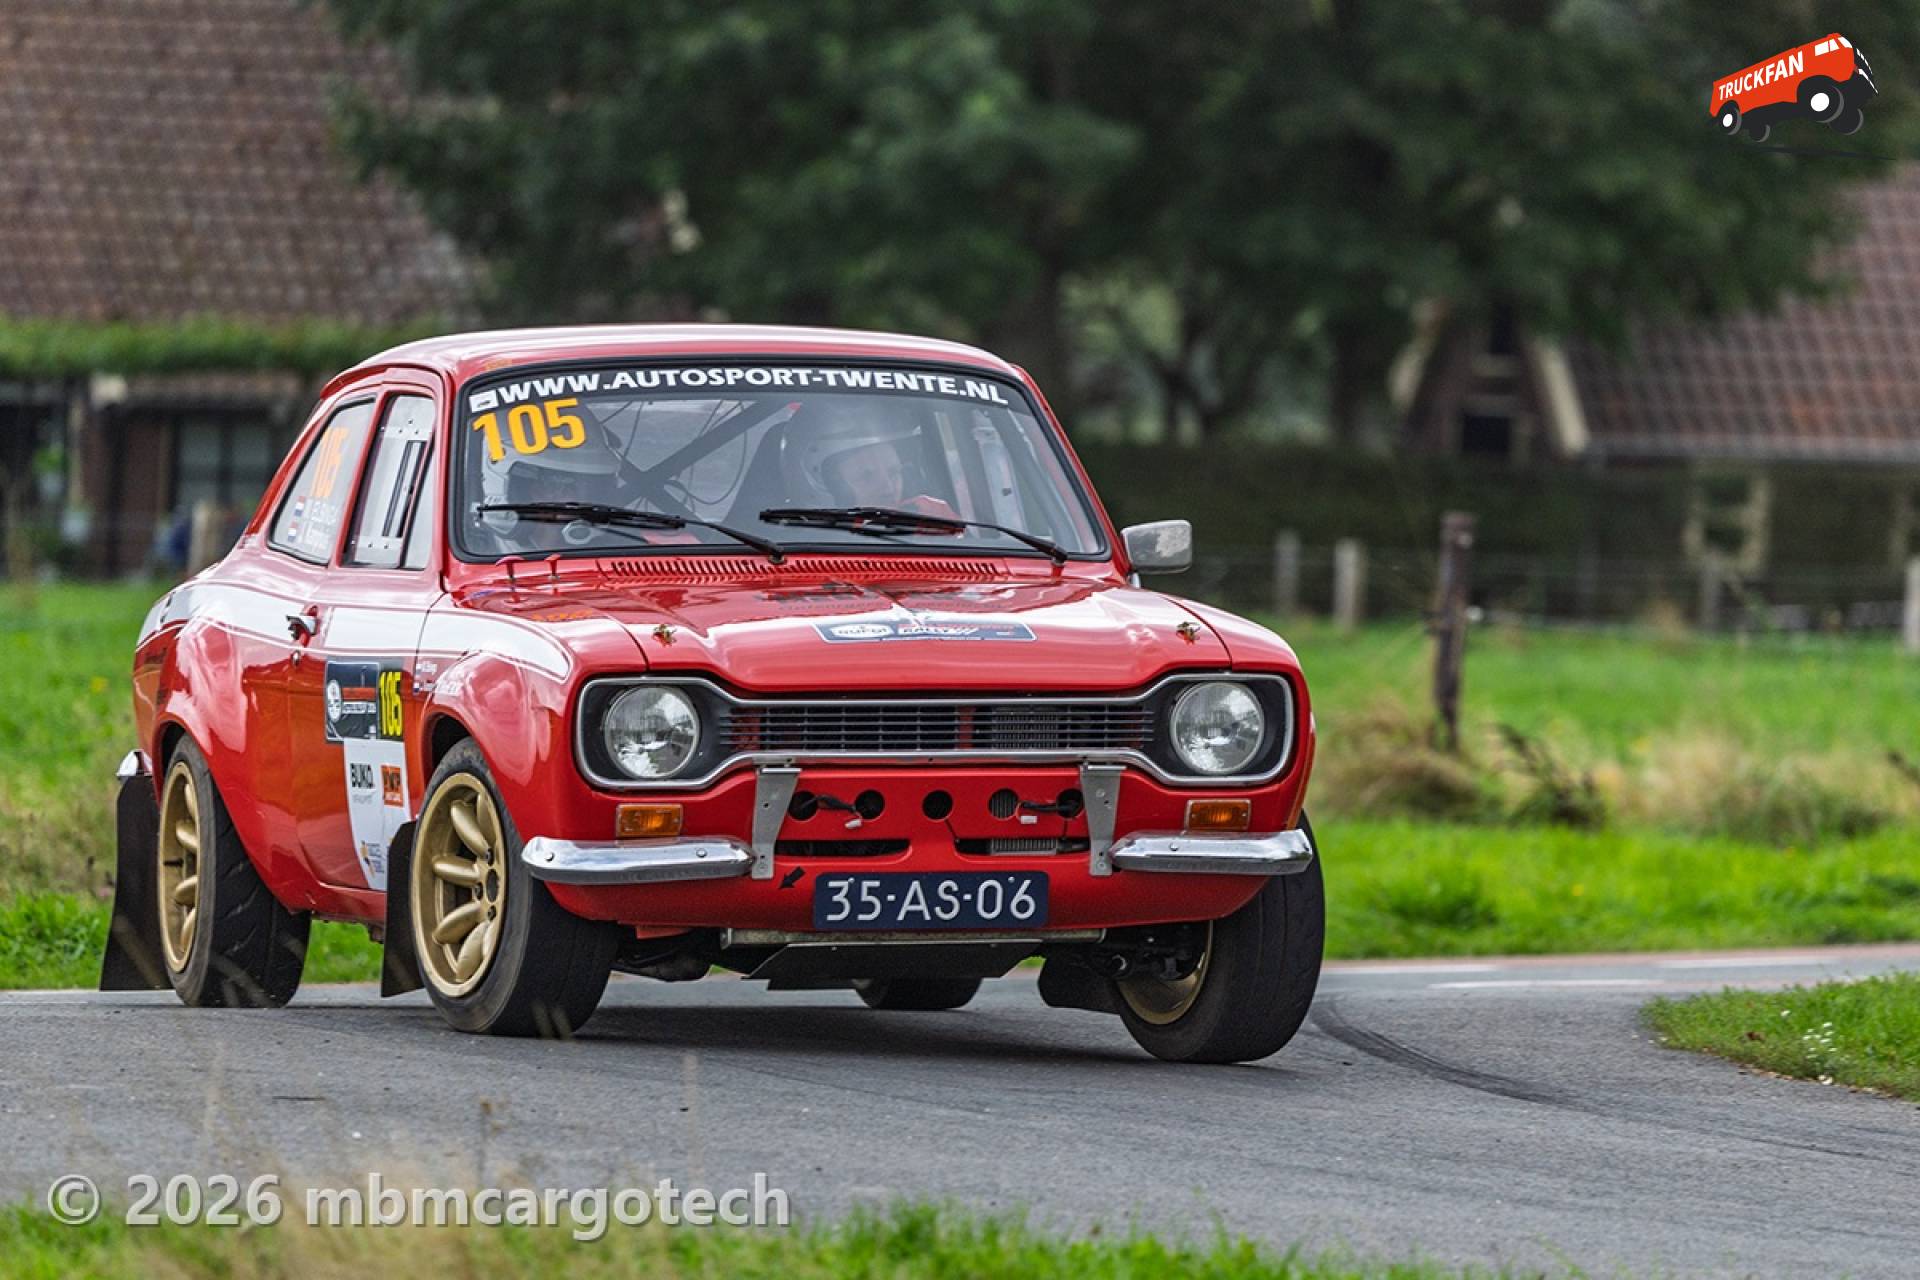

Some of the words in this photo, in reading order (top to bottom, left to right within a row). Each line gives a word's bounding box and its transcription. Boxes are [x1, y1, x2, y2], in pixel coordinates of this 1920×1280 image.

[499, 367, 1009, 405] WWW.AUTOSPORT-TWENTE.NL
[473, 398, 586, 462] 105
[827, 879, 1036, 921] 35-AS-06
